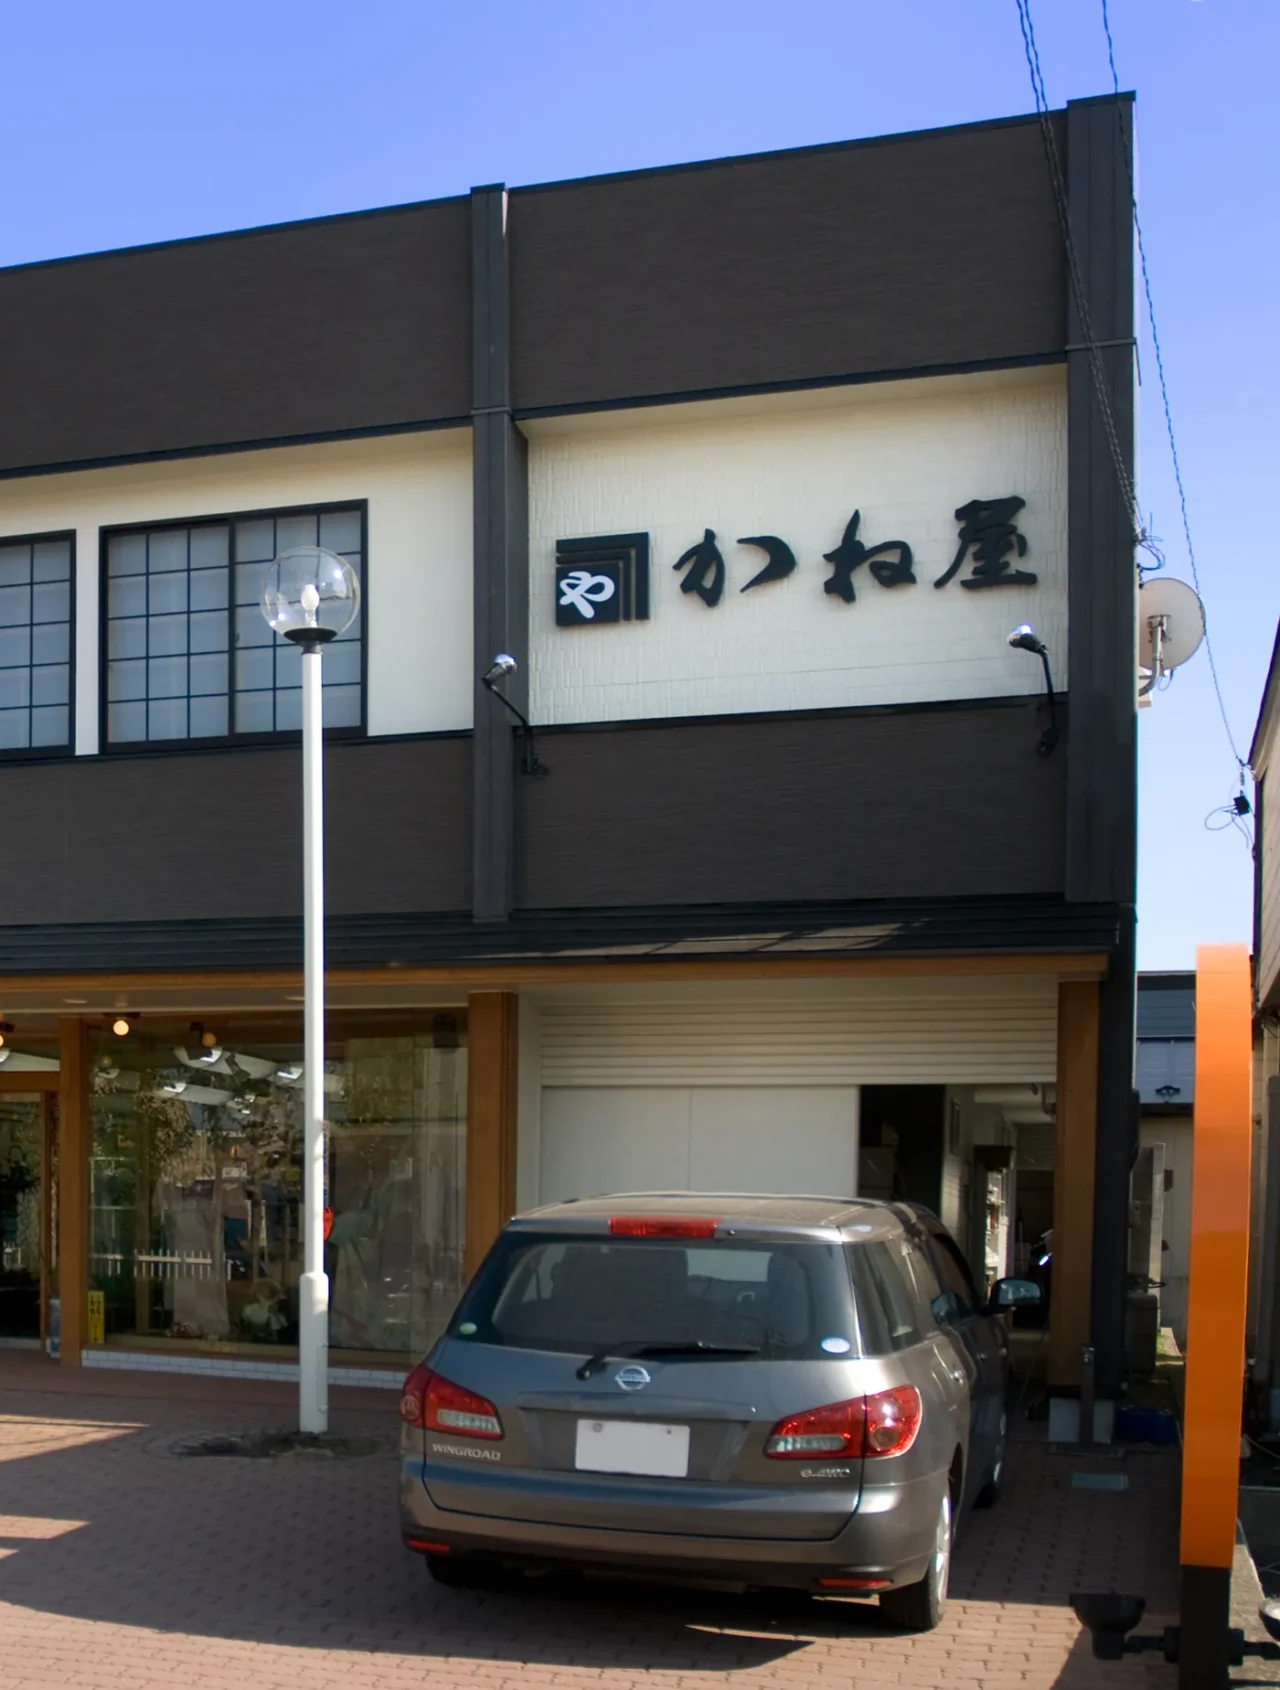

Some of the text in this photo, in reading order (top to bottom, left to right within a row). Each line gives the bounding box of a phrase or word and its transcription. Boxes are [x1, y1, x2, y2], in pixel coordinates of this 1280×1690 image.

[672, 495, 1038, 608] かね屋
[558, 570, 616, 620] や
[432, 1443, 501, 1461] WINGROAD
